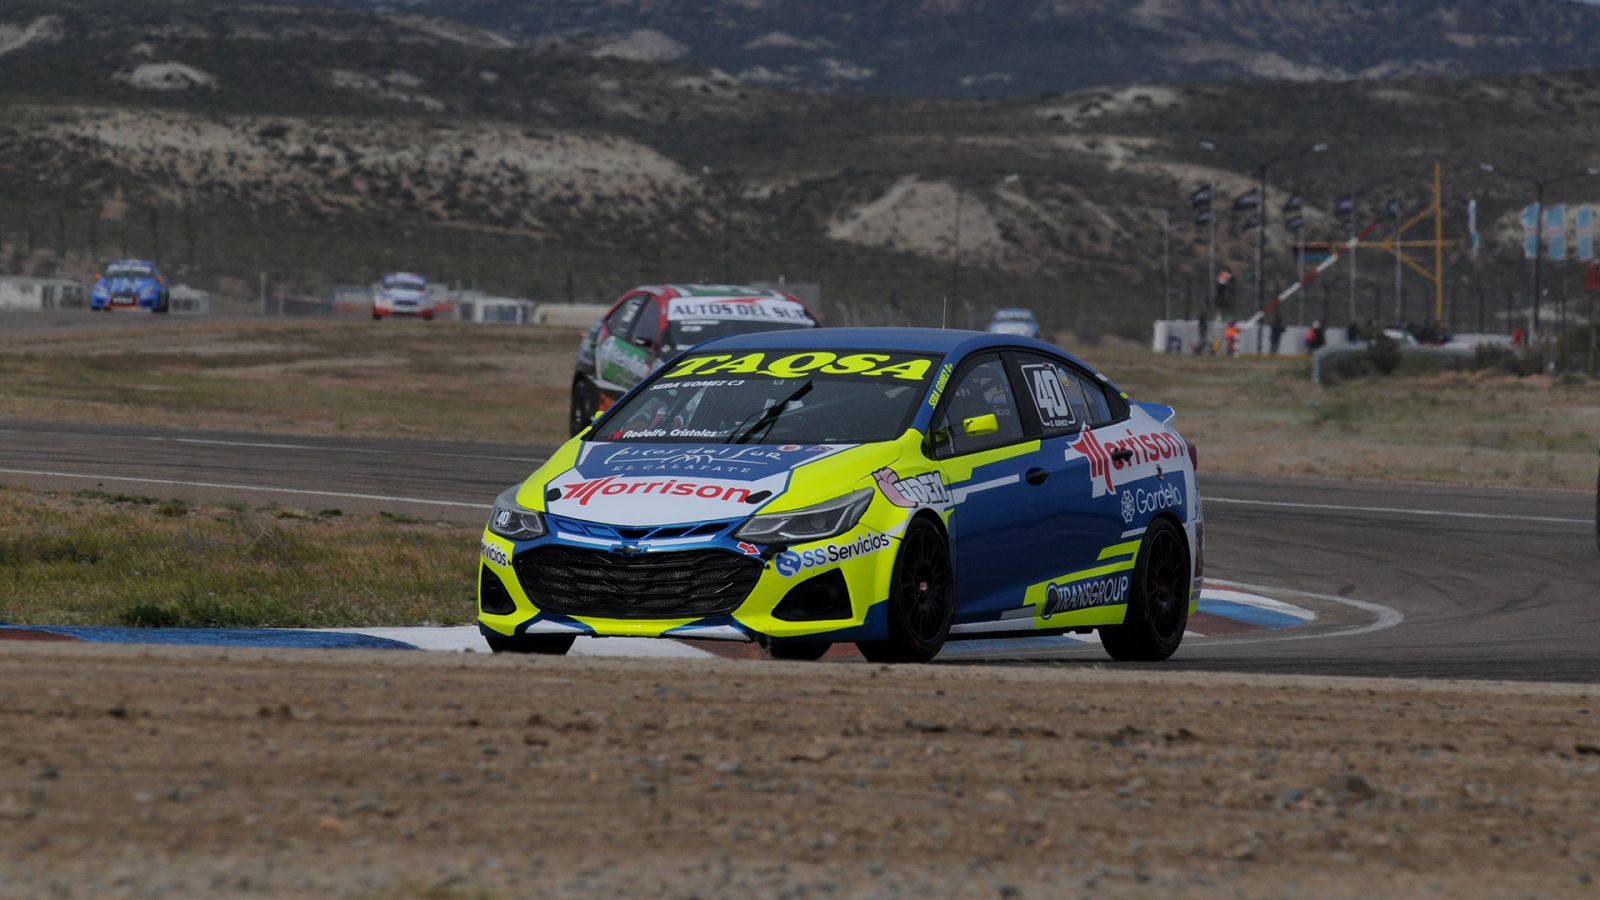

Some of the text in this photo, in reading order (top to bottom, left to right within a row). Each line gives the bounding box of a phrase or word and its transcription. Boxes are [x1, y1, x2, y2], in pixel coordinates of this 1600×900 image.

[672, 303, 733, 315] AUTOS
[735, 304, 771, 317] DEL
[663, 352, 932, 380] TAQSA
[682, 380, 727, 388] GOMEZ
[935, 368, 950, 393] GOMEZ
[1033, 370, 1069, 417] 40
[1072, 425, 1184, 492] Morrison
[563, 477, 751, 505] Morrison
[496, 511, 510, 526] 40
[803, 532, 890, 569] SS Servicios
[1056, 576, 1129, 611] TRANSGROUP
